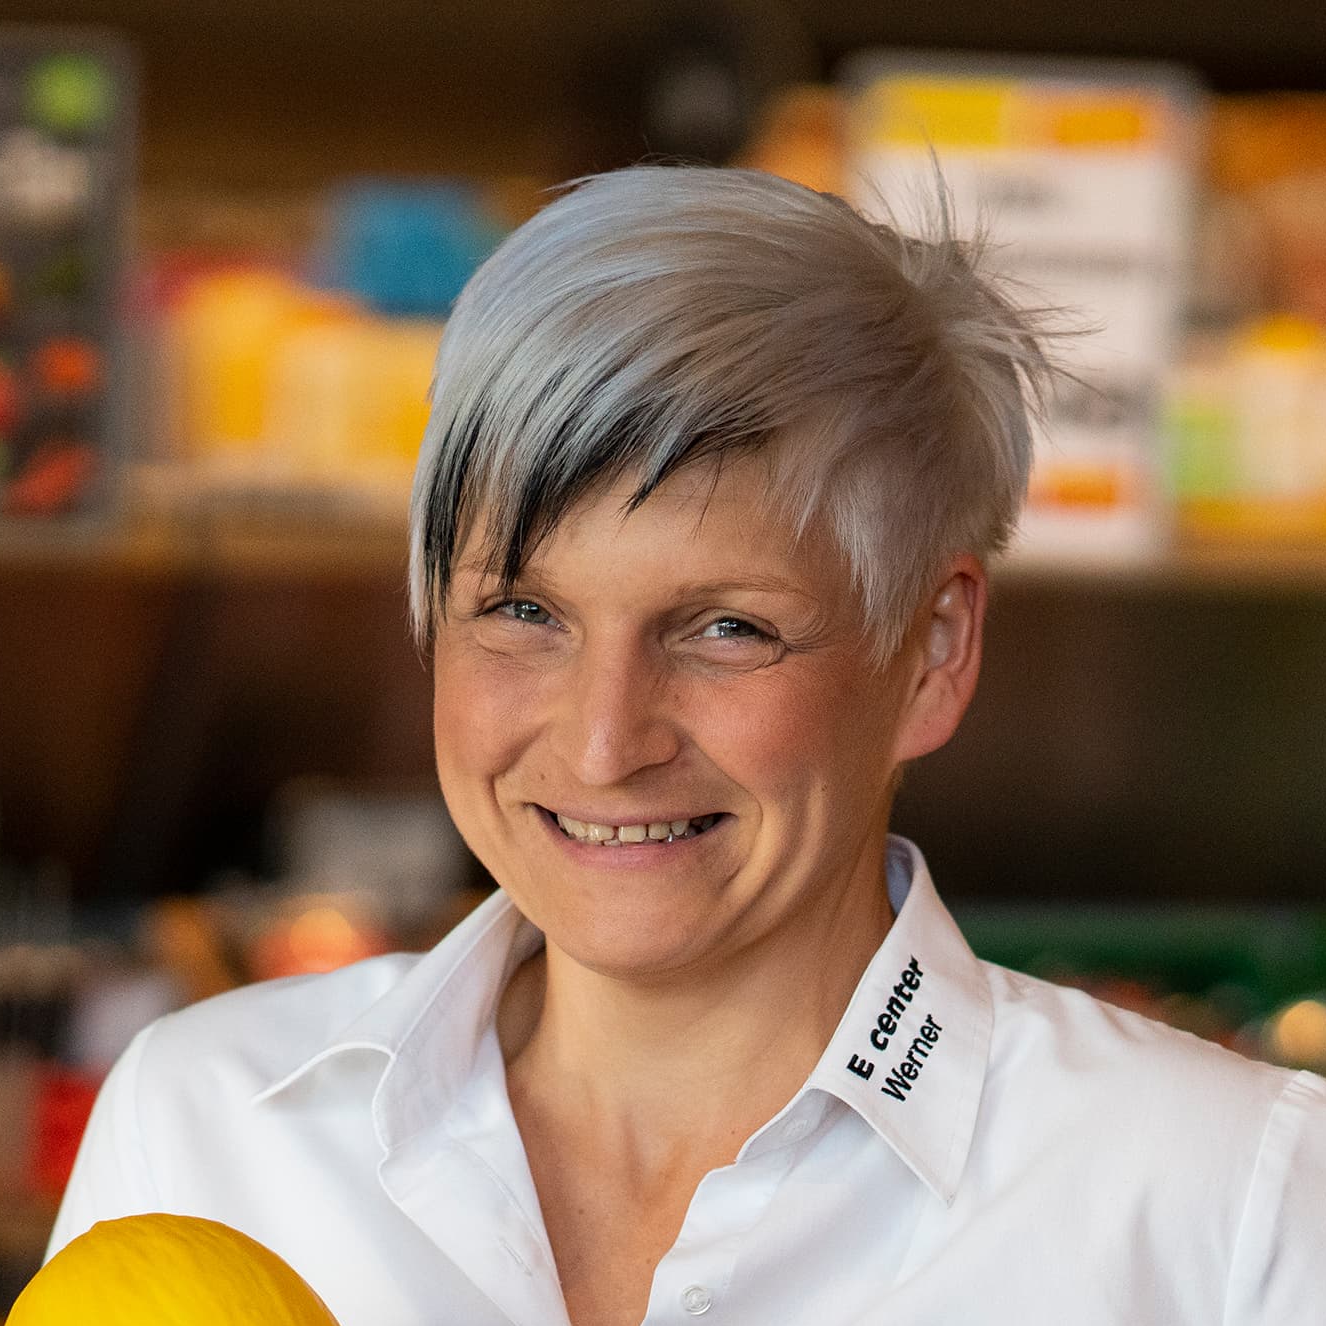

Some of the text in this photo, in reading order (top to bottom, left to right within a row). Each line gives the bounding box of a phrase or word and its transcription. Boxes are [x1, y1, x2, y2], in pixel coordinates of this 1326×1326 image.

[847, 954, 924, 1080] E center
[881, 1013, 943, 1102] Werner
